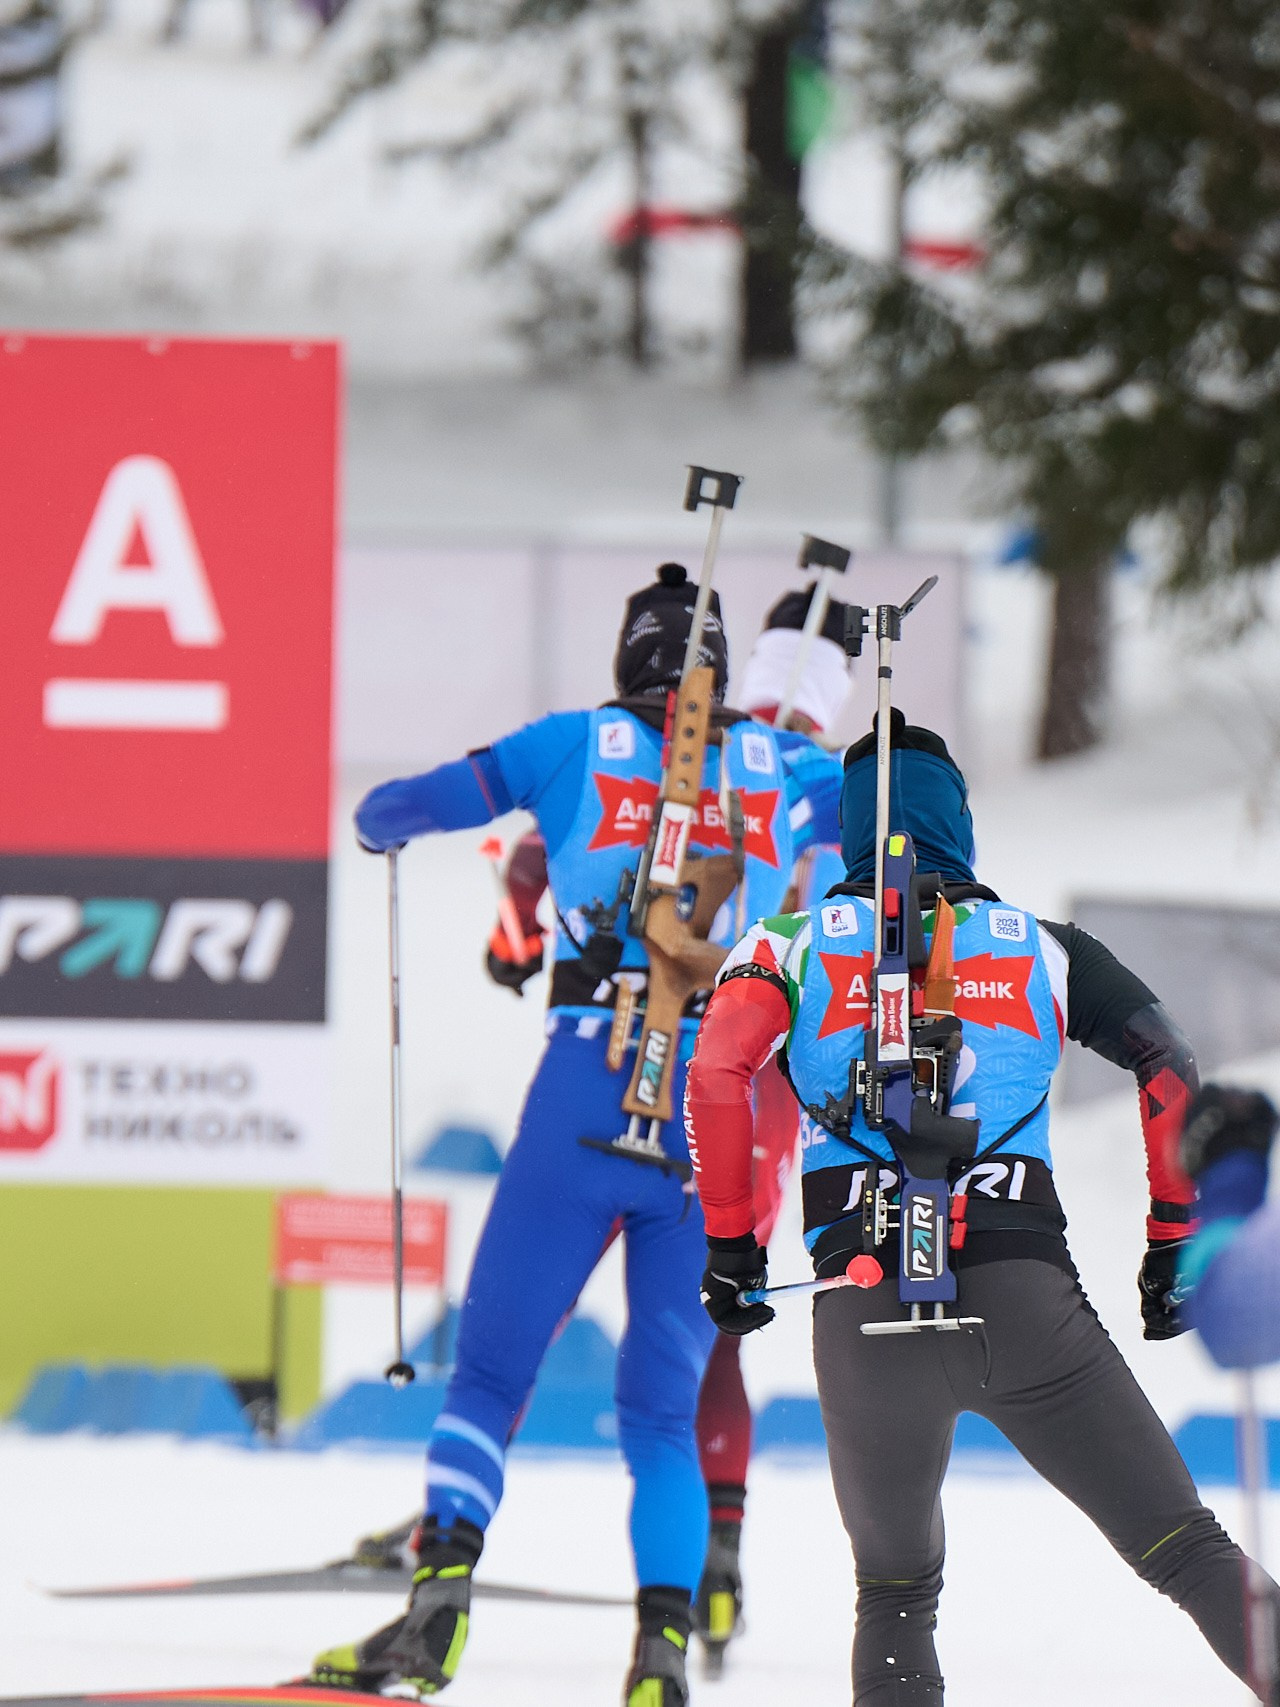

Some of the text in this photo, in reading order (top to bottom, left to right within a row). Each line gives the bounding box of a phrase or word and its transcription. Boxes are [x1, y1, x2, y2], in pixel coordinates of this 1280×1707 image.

[615, 797, 700, 826] Ала
[995, 918, 1019, 928] 2024
[996, 926, 1020, 938] 2025
[79, 1062, 253, 1098] ТЕХНО
[637, 1029, 669, 1107] PARI
[84, 1113, 301, 1149] НИКОЛЬ
[842, 1161, 1027, 1211] PRI
[912, 1195, 933, 1275] PARI
